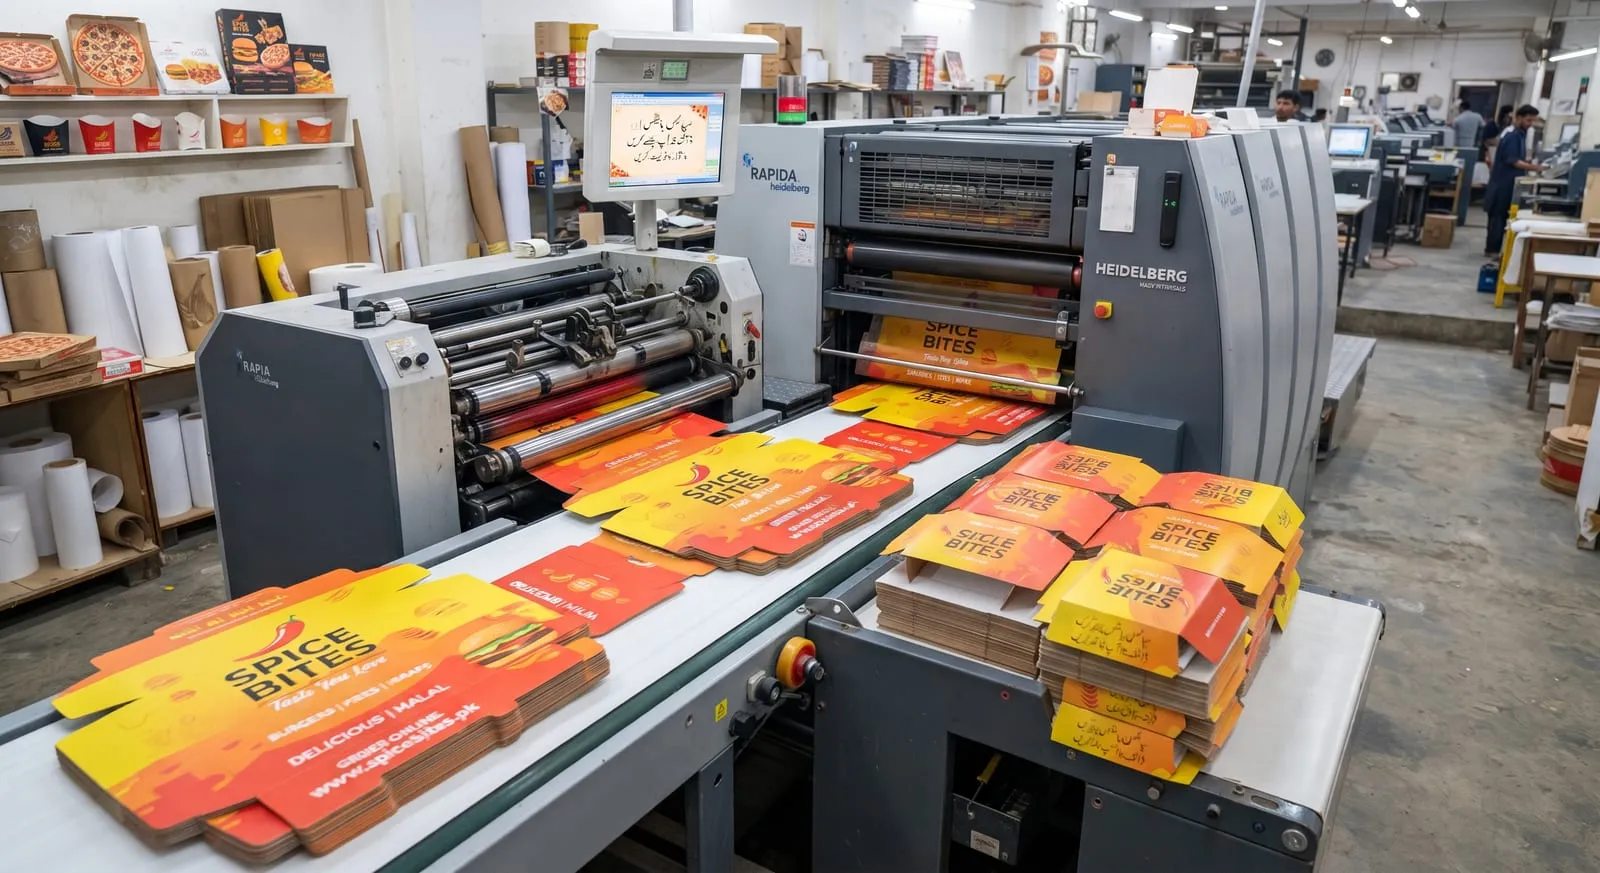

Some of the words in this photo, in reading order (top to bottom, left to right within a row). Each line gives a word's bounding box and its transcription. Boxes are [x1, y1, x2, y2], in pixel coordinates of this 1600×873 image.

[750, 166, 798, 183] RAPIDA
[770, 182, 810, 194] heidelberg
[1095, 262, 1188, 283] HEIDELBERG
[925, 320, 979, 338] SPICE
[923, 334, 977, 355] BITES
[242, 360, 271, 377] RAPIA
[682, 468, 753, 500] SPICE
[702, 474, 771, 506] BITES
[1003, 494, 1053, 512] BITES
[1150, 531, 1216, 552] BITES
[1157, 522, 1221, 543] SPICE
[944, 538, 1008, 559] BITES
[224, 627, 359, 687] SPICE
[352, 656, 387, 676] Love
[241, 639, 377, 702] BITES
[287, 715, 385, 767] DELICIOUS
[392, 684, 451, 714] MALAL
[388, 711, 445, 742] ONLINE
